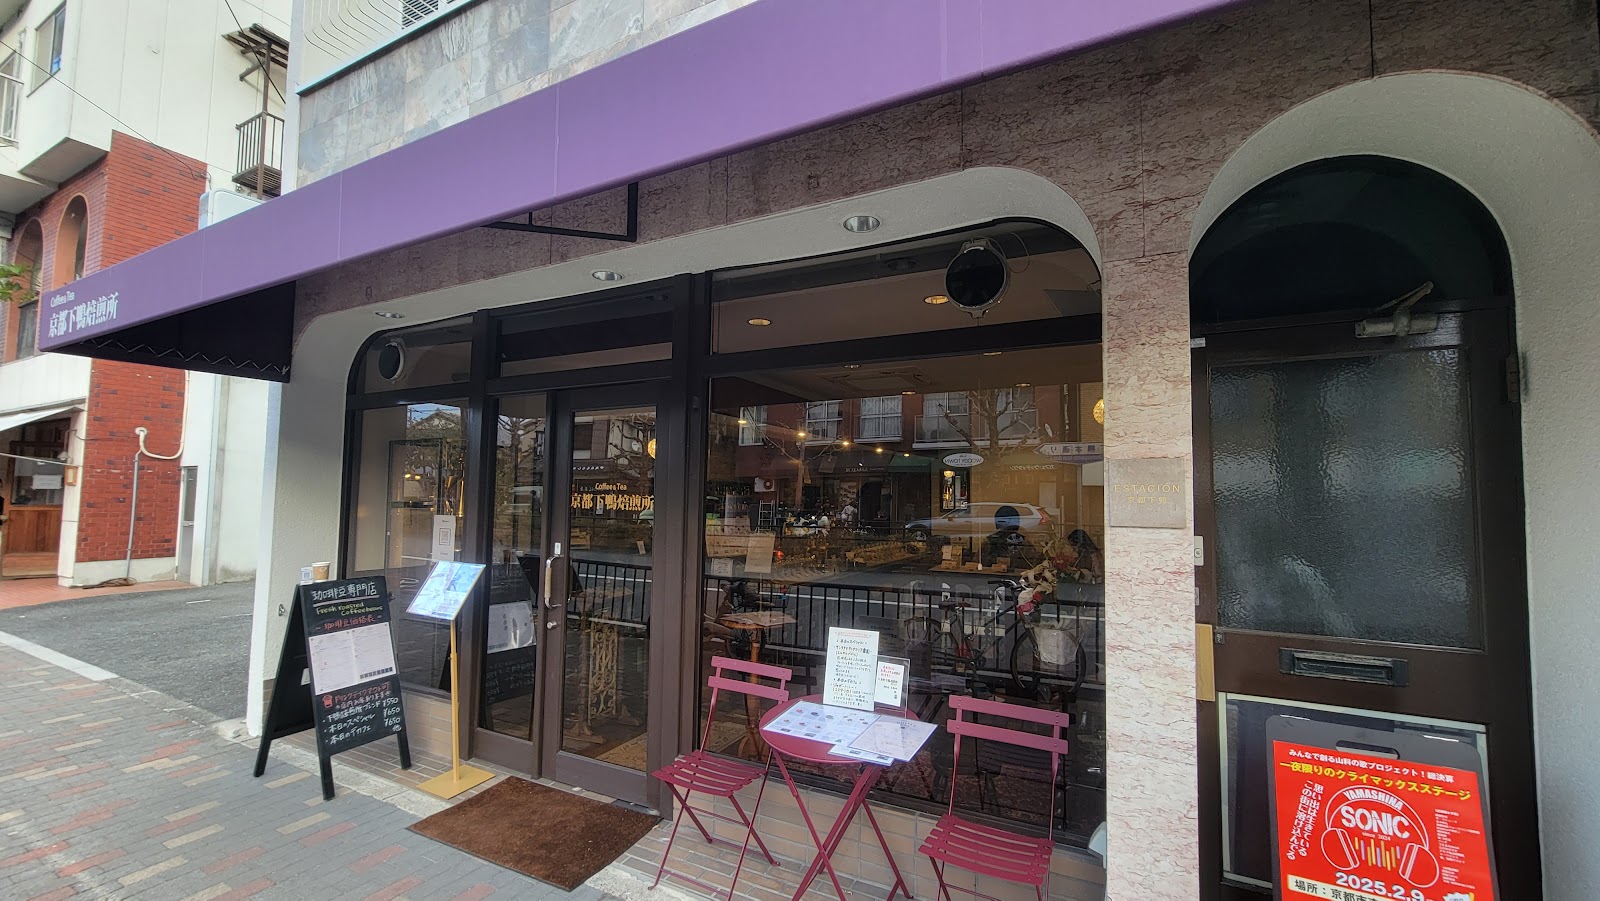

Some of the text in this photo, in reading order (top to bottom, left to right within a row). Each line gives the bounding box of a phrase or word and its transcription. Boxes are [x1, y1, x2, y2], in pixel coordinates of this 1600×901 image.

[48, 291, 119, 338] 京都下鴨焙煎所
[570, 493, 655, 511] 京都下鴨焙煎所
[311, 581, 377, 601] 珈琲豆専門店
[1279, 760, 1472, 801] 一夜限りのクライマックスステージ
[1343, 788, 1404, 810] YAMASHINA
[1298, 783, 1324, 857] 思い出は生きている
[1340, 805, 1411, 840] SONIC
[1294, 878, 1379, 901] 場所：京都市
[1335, 871, 1425, 901] 2025.2.9
